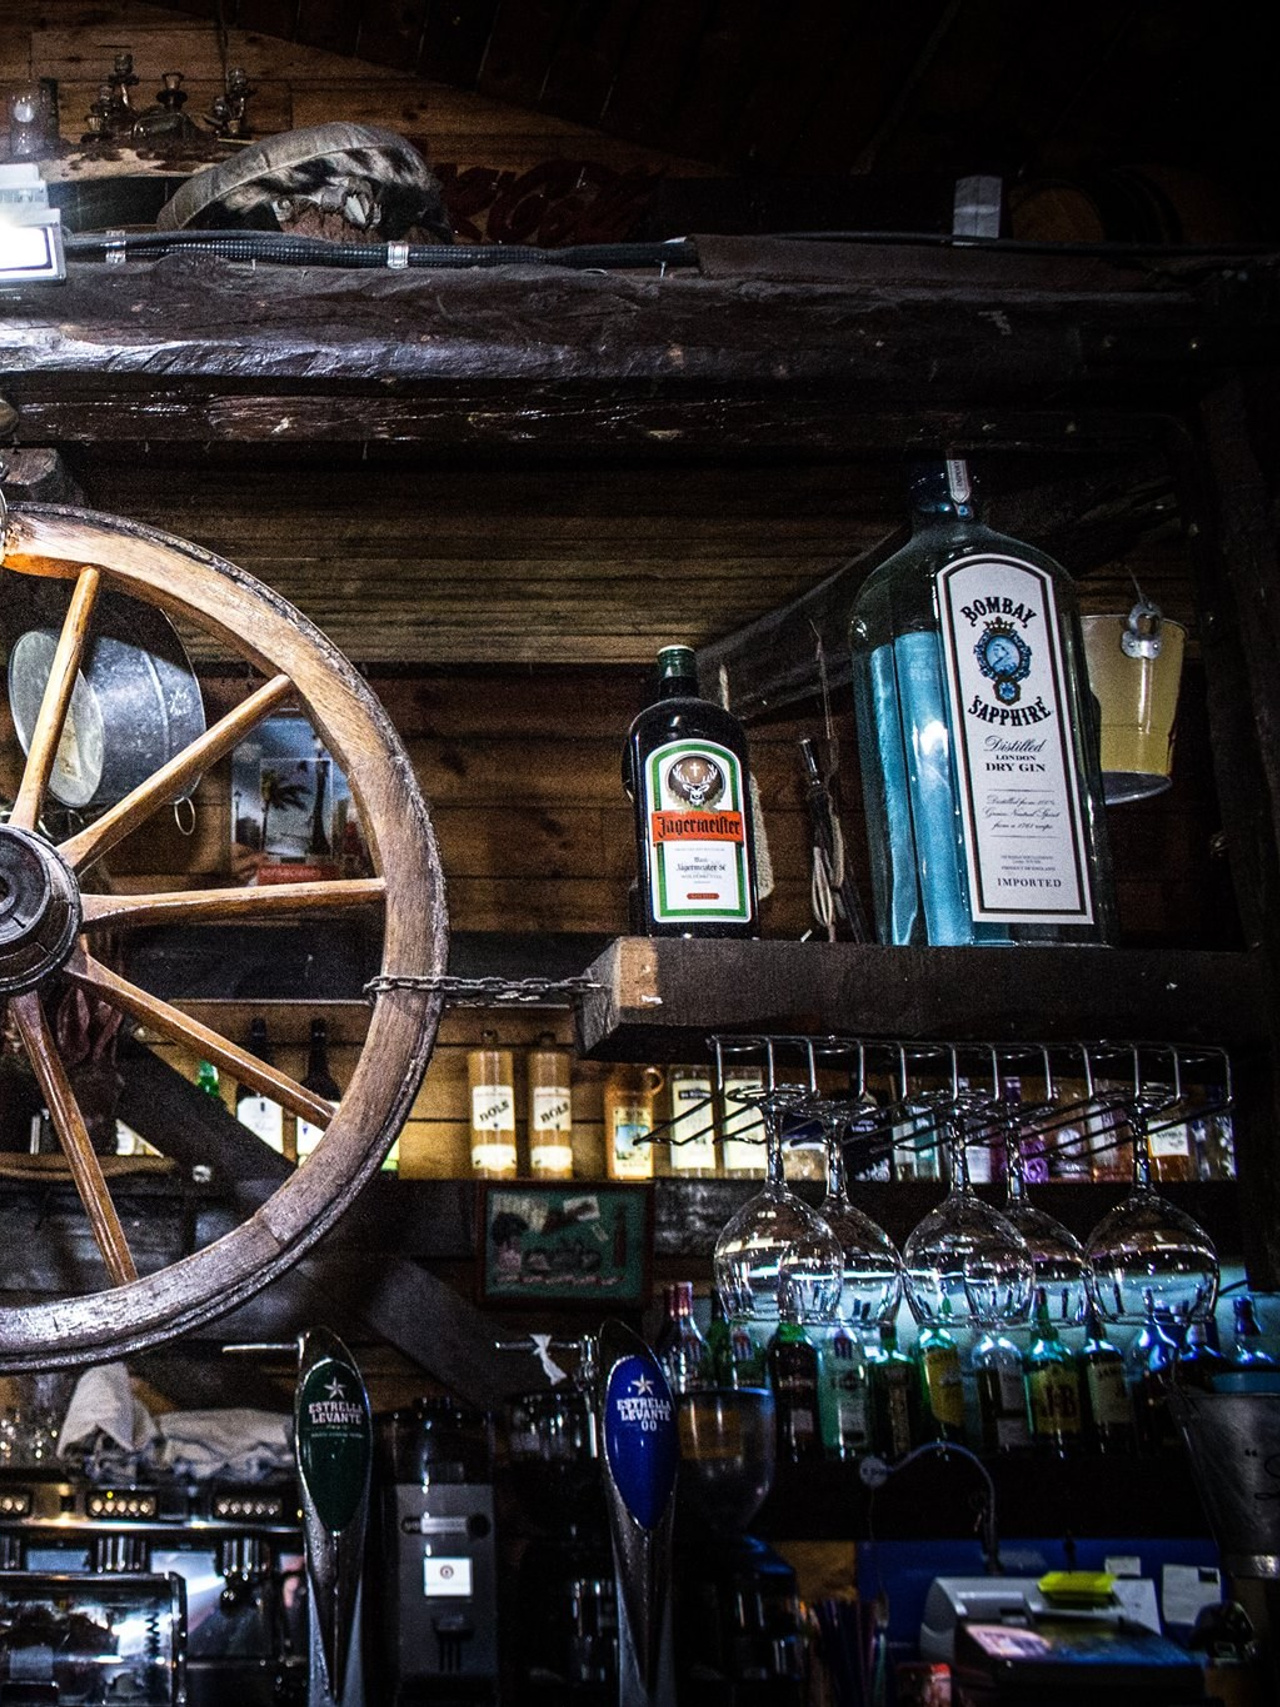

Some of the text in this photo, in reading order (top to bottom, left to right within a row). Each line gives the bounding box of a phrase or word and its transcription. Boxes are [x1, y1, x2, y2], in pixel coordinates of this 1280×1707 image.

[960, 596, 1037, 629] BOMBAY
[968, 695, 1052, 727] SAPPHIRE
[983, 735, 1048, 753] Distilled
[985, 762, 1046, 772] DRY GIN
[997, 877, 1062, 888] IMPORTED
[478, 1100, 510, 1123] BOLS
[540, 1101, 571, 1124] BOLS
[308, 1400, 364, 1415] ESTRELLA
[616, 1397, 672, 1412] ESTRELLA
[311, 1412, 362, 1425] LEVANTE
[620, 1409, 671, 1422] LEVANTE
[640, 1419, 658, 1432] 00
